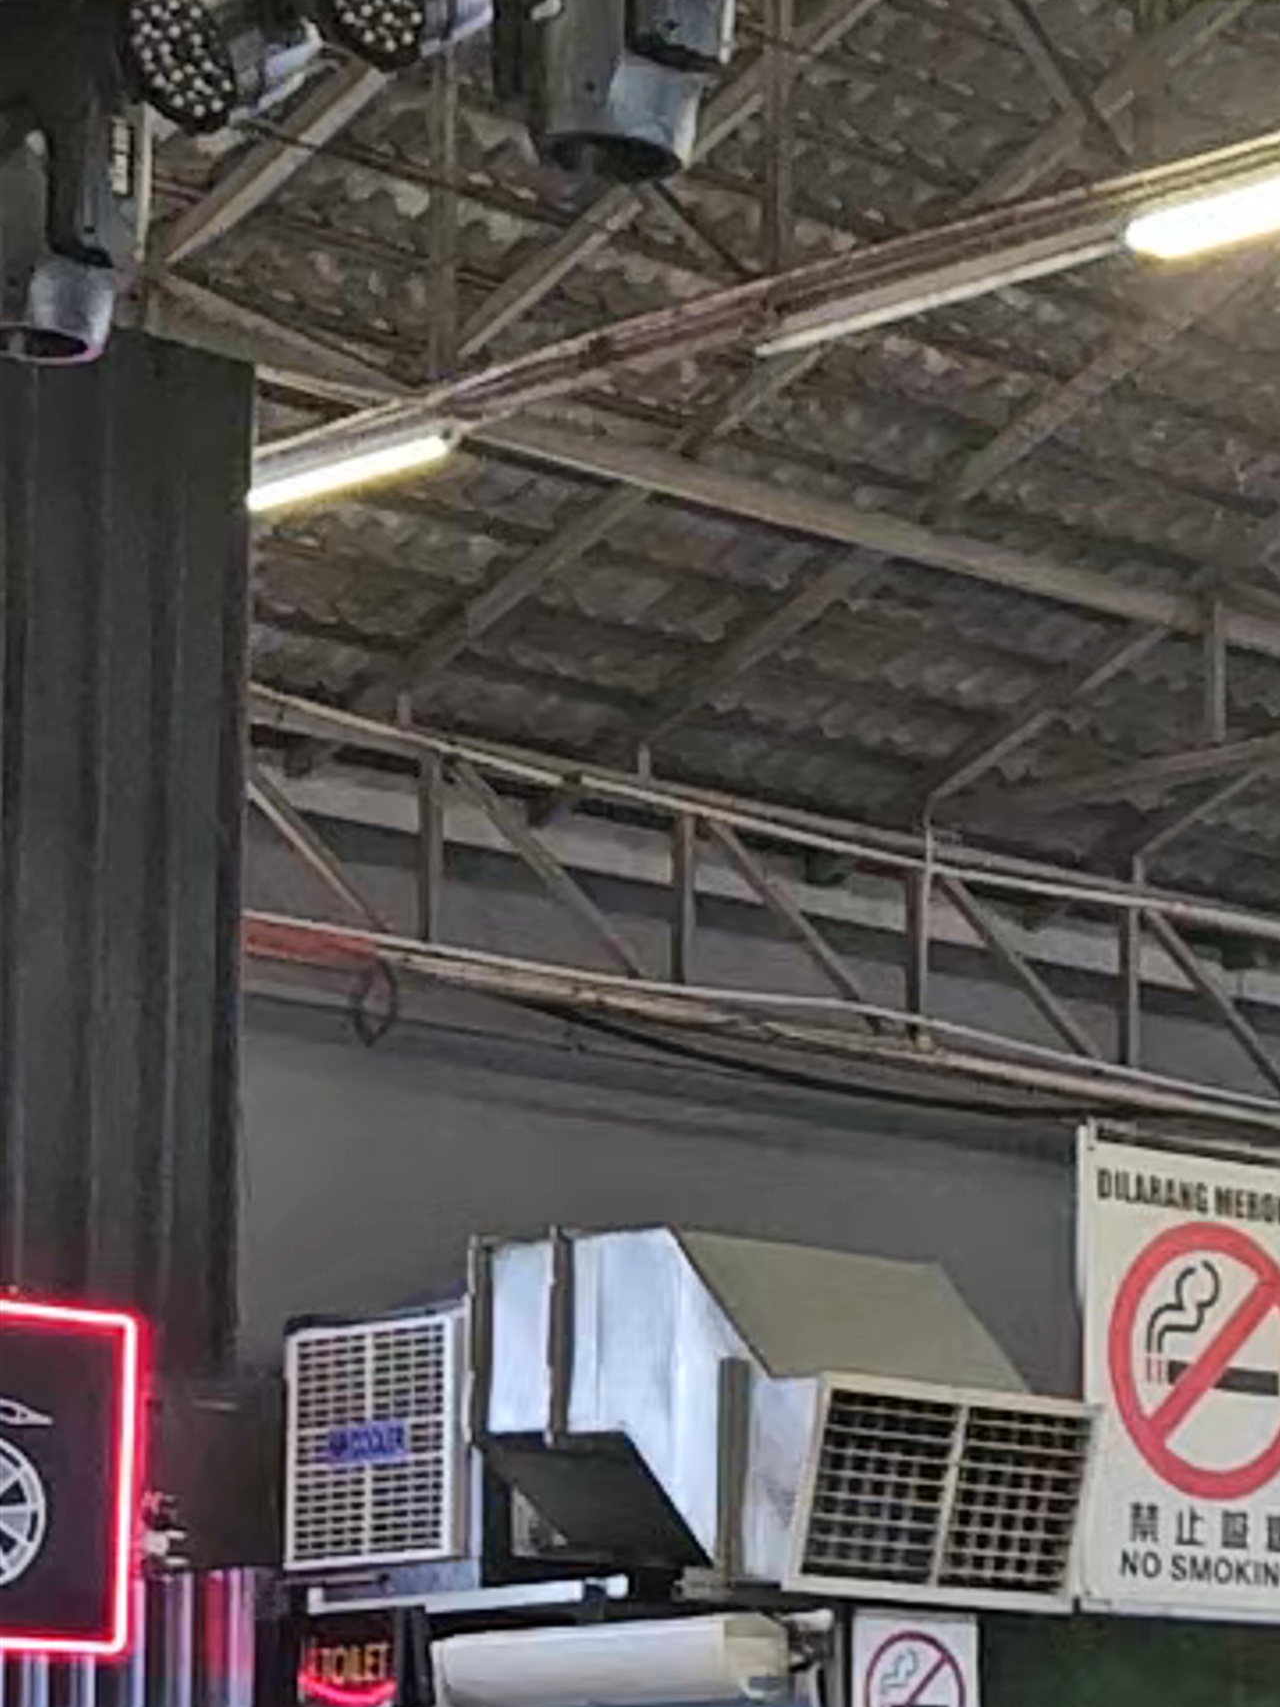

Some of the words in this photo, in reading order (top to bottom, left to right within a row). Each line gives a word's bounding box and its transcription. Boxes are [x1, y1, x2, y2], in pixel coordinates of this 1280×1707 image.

[1096, 1168, 1209, 1215] DILARANG
[1120, 1549, 1162, 1578] NO
[320, 1643, 390, 1684] TOILET
